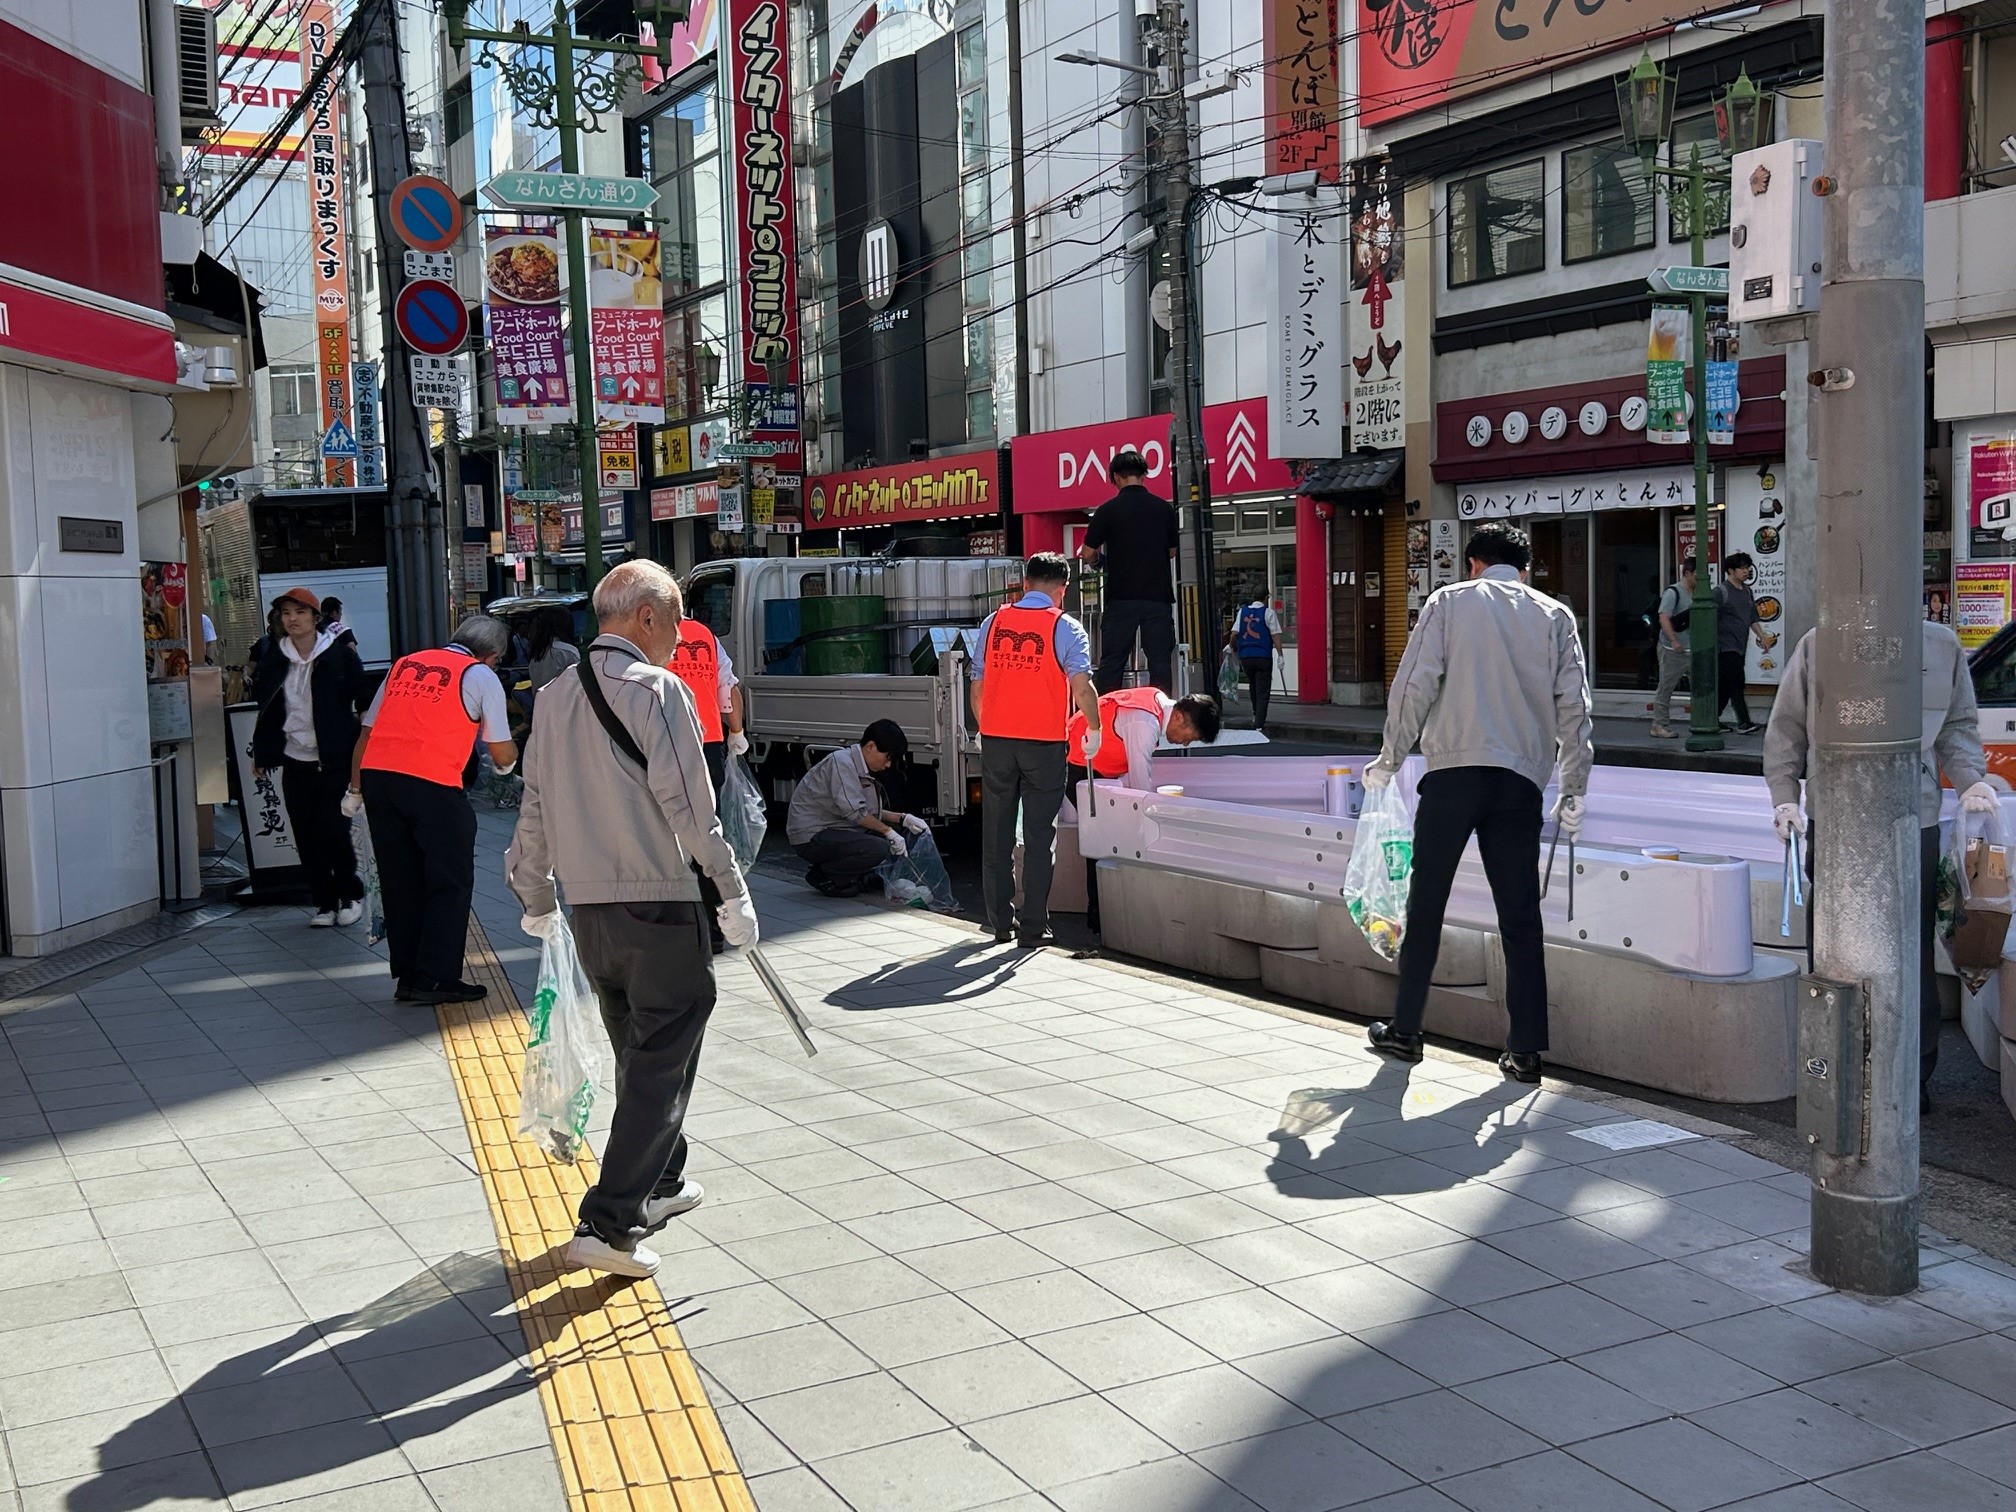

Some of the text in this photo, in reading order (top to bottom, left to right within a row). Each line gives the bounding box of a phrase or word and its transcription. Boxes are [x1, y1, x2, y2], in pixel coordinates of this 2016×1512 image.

[309, 22, 341, 279] DVDるなら買取りまっくす
[1279, 145, 1303, 164] 2F
[515, 177, 637, 204] なんさん通り
[406, 253, 452, 265] 自動車
[407, 264, 453, 279] ここまで
[492, 308, 541, 318] コミュニティー
[593, 310, 643, 319] コミュニティー
[1293, 210, 1326, 428] 米とデミグラス
[492, 315, 560, 332] フードホール
[594, 317, 662, 333] フードホール
[323, 328, 343, 339] 5F
[494, 330, 560, 344] Food Court
[595, 331, 661, 344] Food Court
[496, 342, 555, 361] 푸드코트
[596, 342, 655, 360] 푸드코트
[1285, 349, 1291, 361] TO
[326, 364, 344, 375] 1F
[413, 358, 457, 369] 自動車
[497, 358, 559, 378] 美食廣場
[597, 359, 656, 376] 美食廣場
[415, 371, 458, 382] ここから
[1648, 367, 1684, 378] フードホール
[416, 382, 458, 394] 貨物集配中の
[1354, 381, 1402, 398] 階段を上がって
[1648, 379, 1665, 387] Food
[417, 394, 457, 406] 貨物を除く
[1356, 398, 1401, 426] 2階に
[1353, 427, 1403, 445] ございます。
[606, 455, 631, 467] 免税
[1058, 440, 1164, 489] DAIO
[832, 468, 989, 518] インターネット&コミックカフェ
[1484, 480, 1696, 510] ハンバーグ×とんか
[993, 652, 1042, 664] ミナミまち育て
[992, 661, 1041, 673] ネットワーク
[392, 681, 445, 697] ミナミまち育て
[387, 690, 441, 703] ネットワーク
